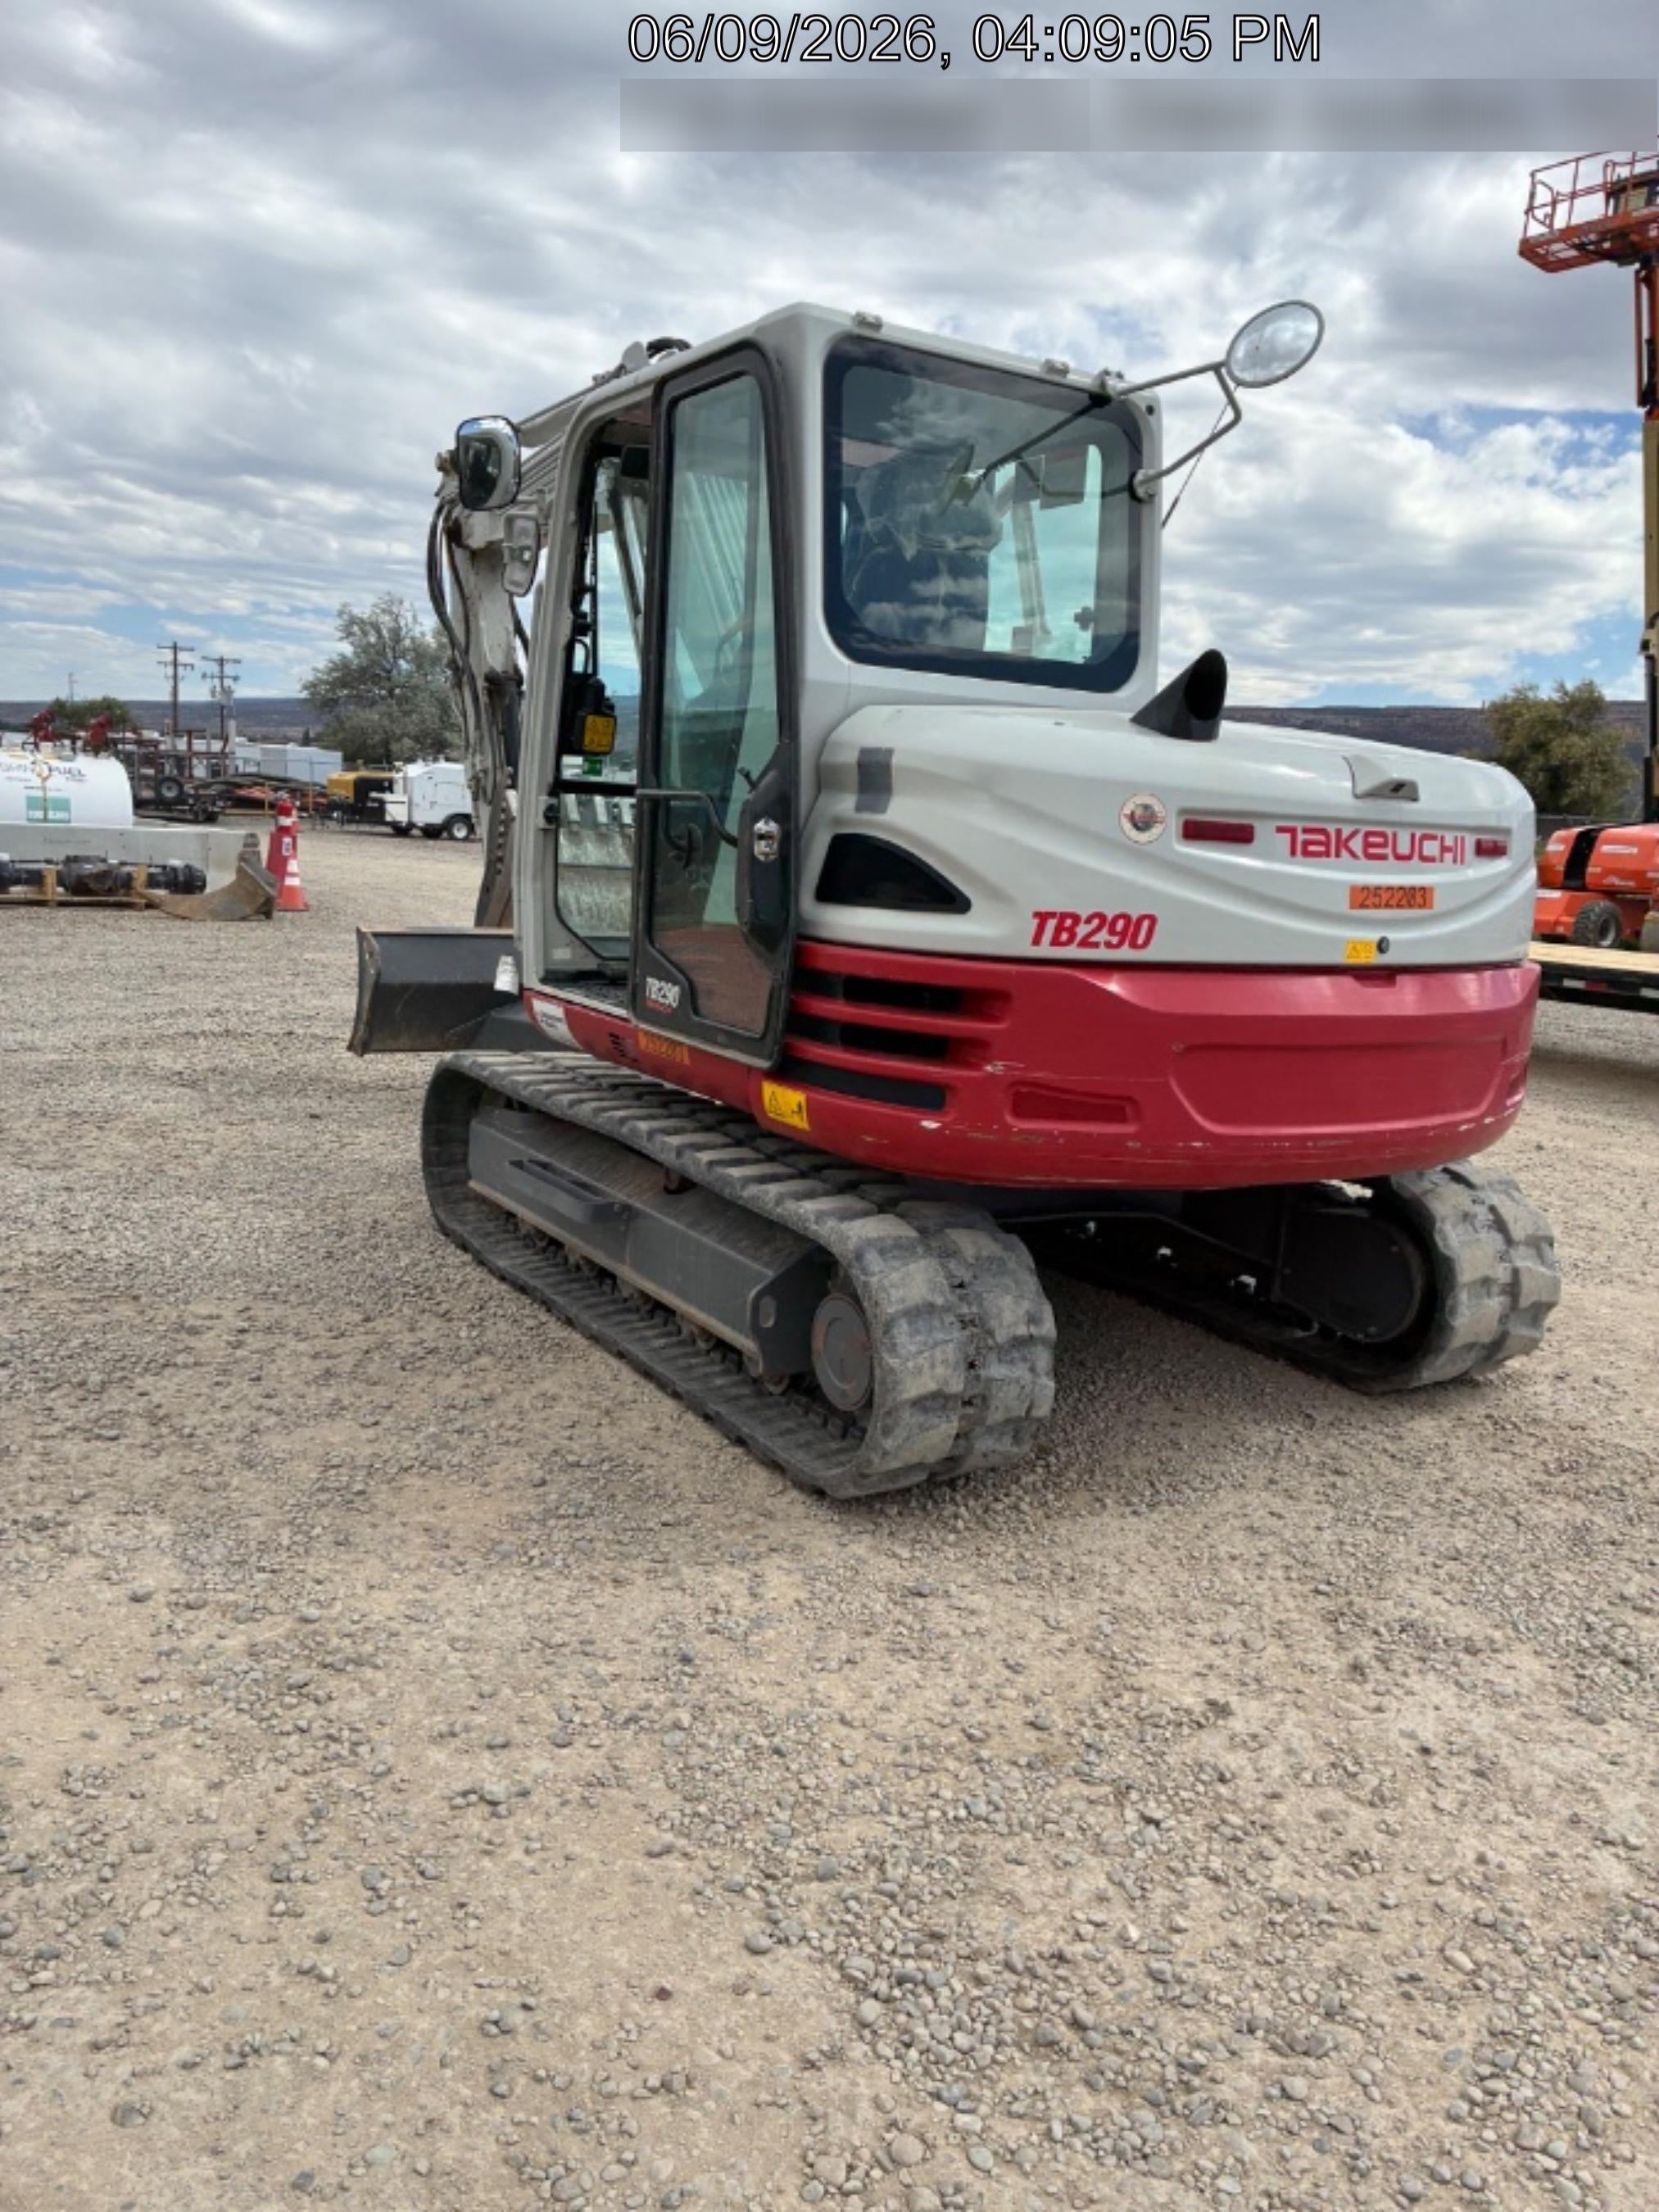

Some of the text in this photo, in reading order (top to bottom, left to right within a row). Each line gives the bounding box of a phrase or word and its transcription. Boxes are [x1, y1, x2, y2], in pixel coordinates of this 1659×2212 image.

[1275, 825, 1466, 865] TAKEUCHI
[1031, 910, 1158, 950] TB290
[645, 975, 681, 1009] TB290
